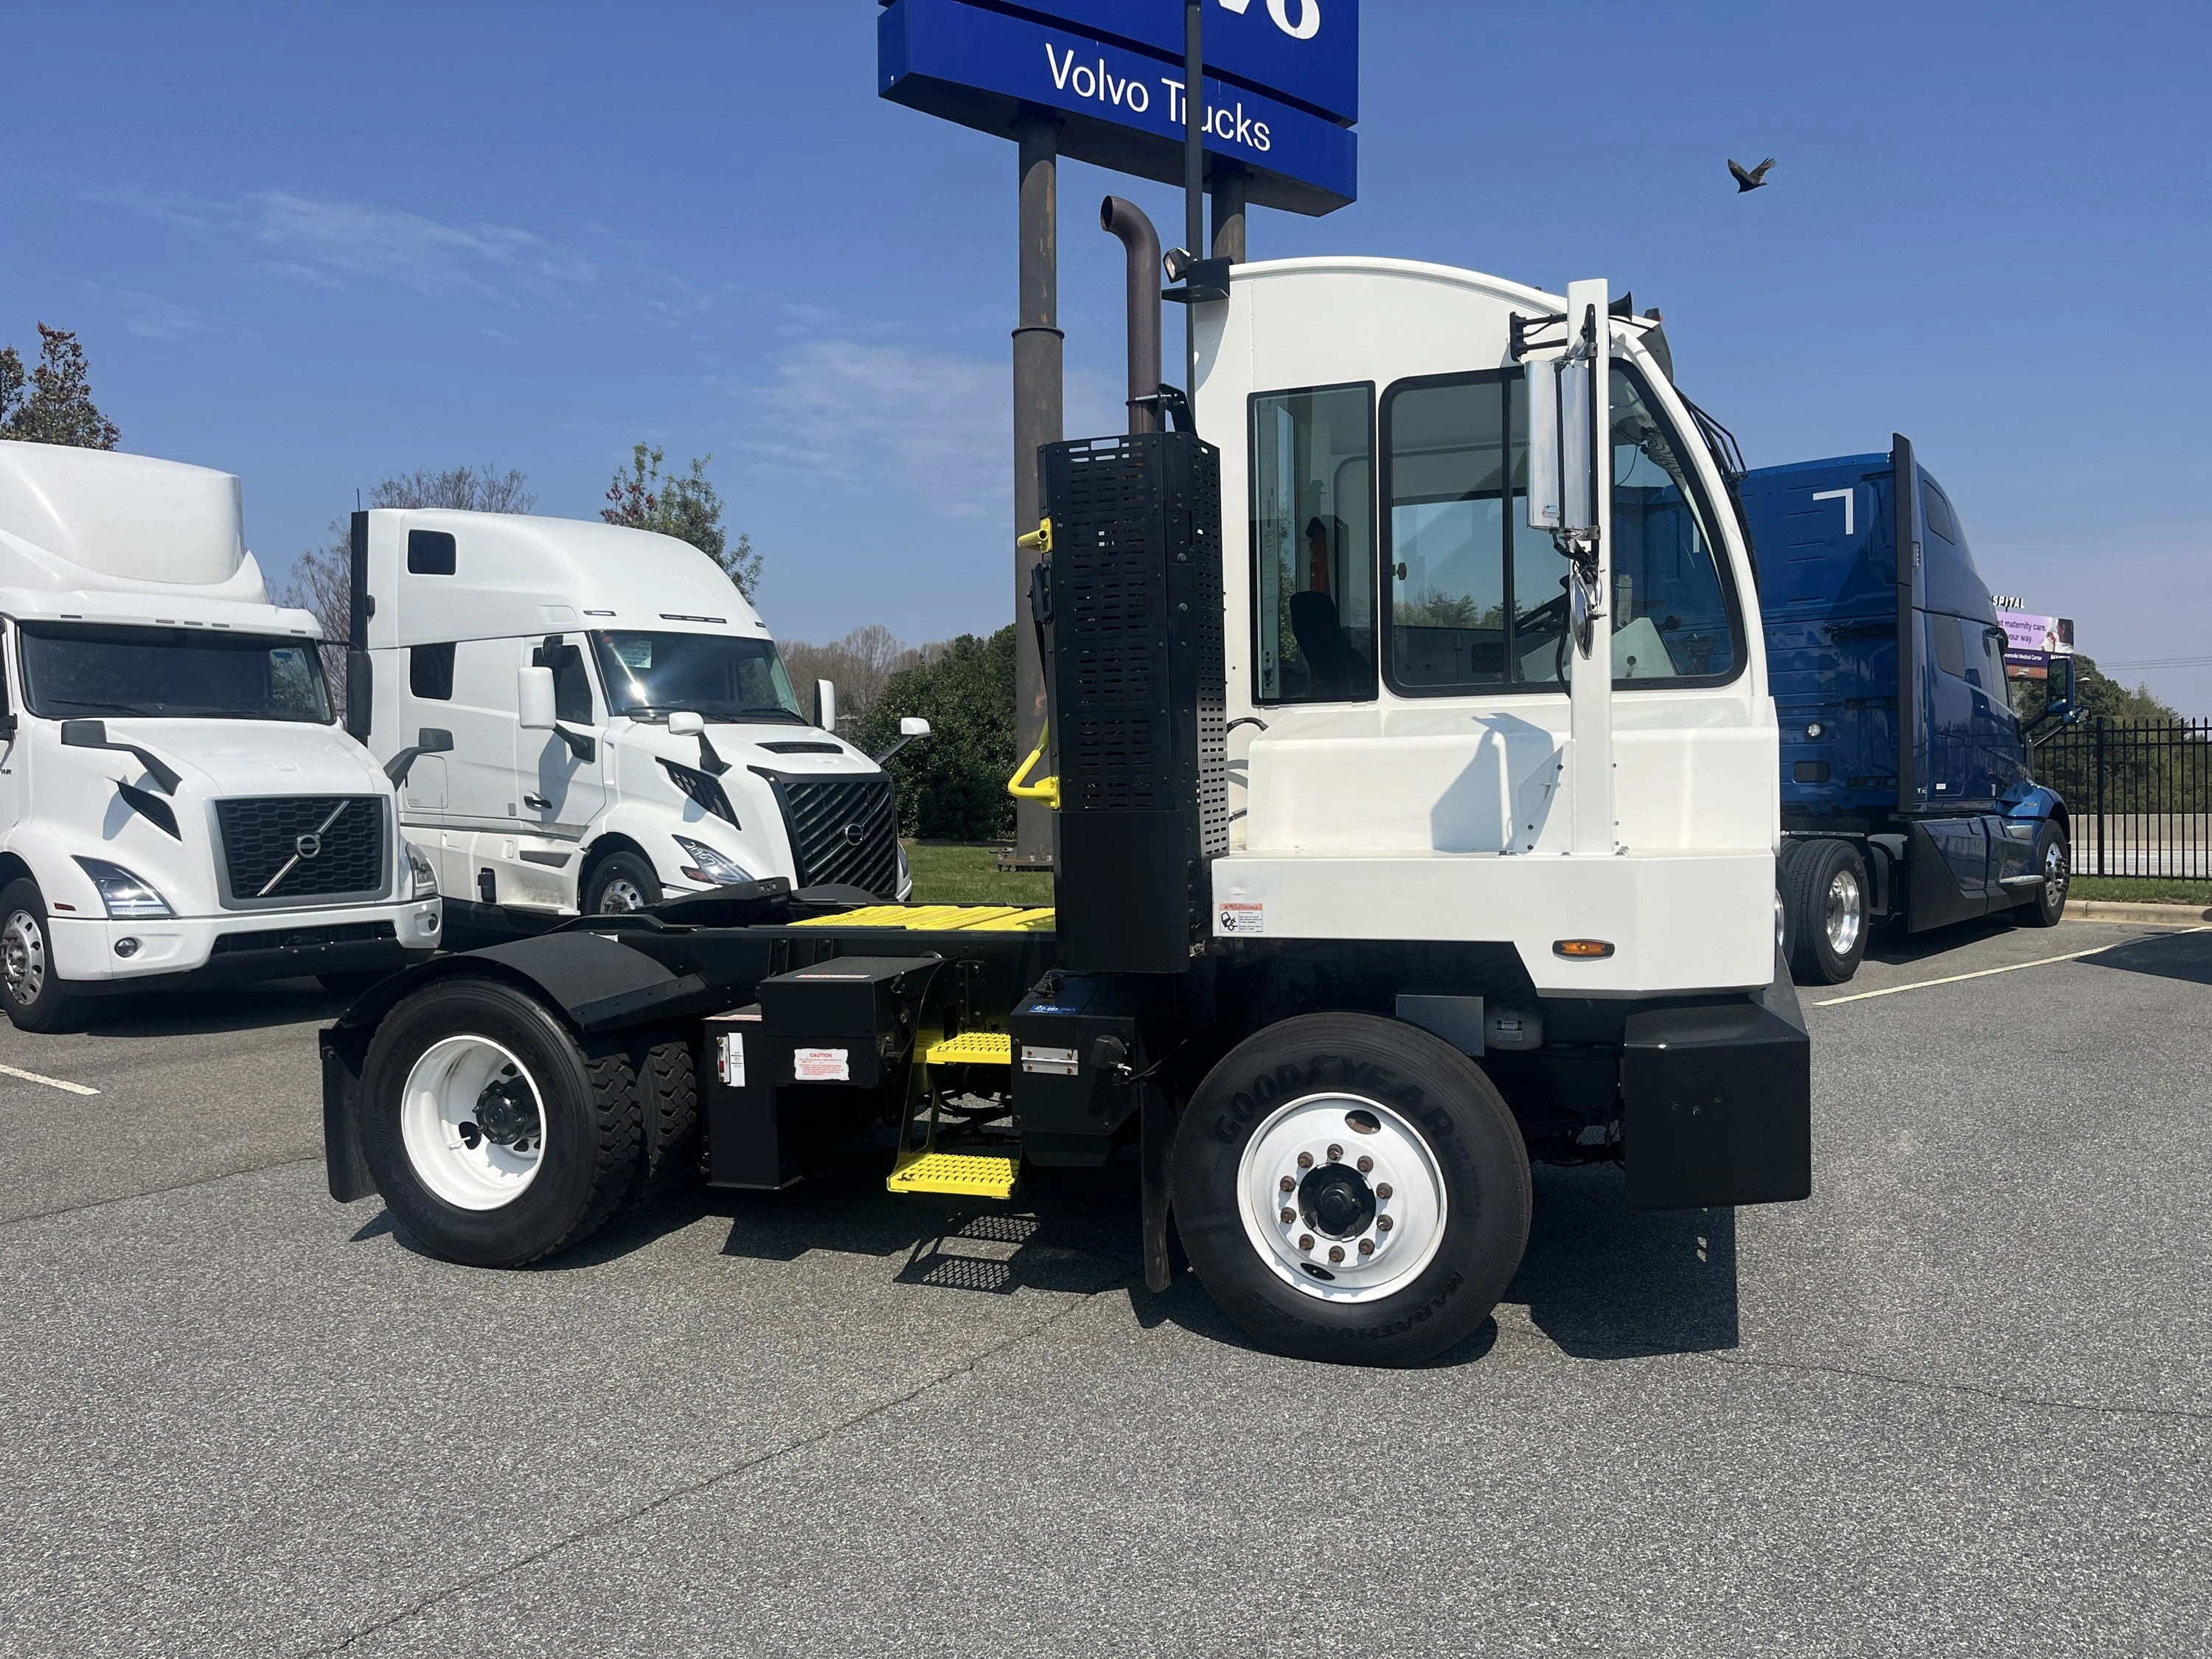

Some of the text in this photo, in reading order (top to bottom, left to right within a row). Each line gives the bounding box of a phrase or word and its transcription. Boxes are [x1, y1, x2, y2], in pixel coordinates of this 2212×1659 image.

[1046, 43, 1149, 113] Volvo
[2005, 621, 2032, 632] maternity
[2033, 624, 2047, 632] care.
[1214, 1055, 1456, 1144] GOODYEAR
